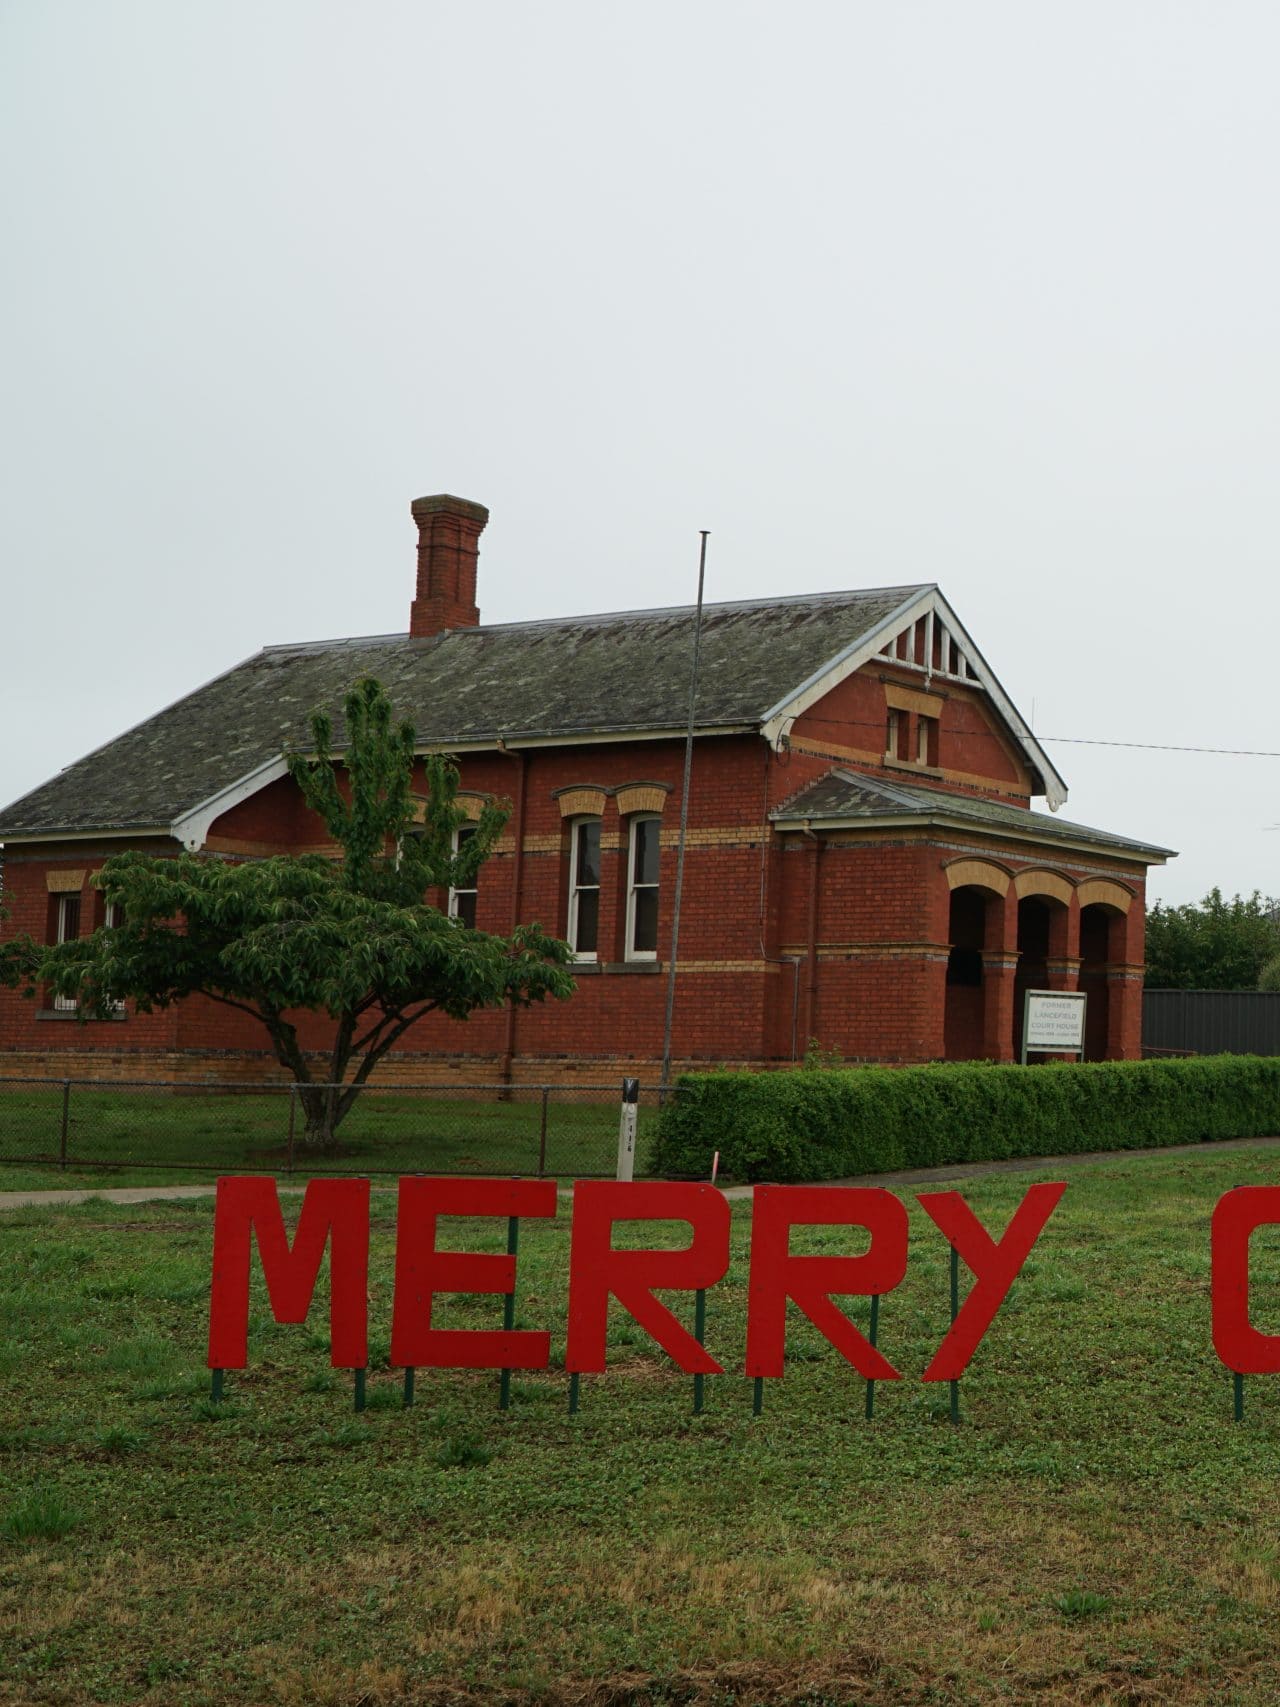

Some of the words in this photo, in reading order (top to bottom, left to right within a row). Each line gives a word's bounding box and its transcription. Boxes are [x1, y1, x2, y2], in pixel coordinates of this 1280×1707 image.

[1041, 1001, 1072, 1009] FORMER
[1034, 1011, 1077, 1020] LANCEFIELD
[207, 1175, 1069, 1382] MERRY
